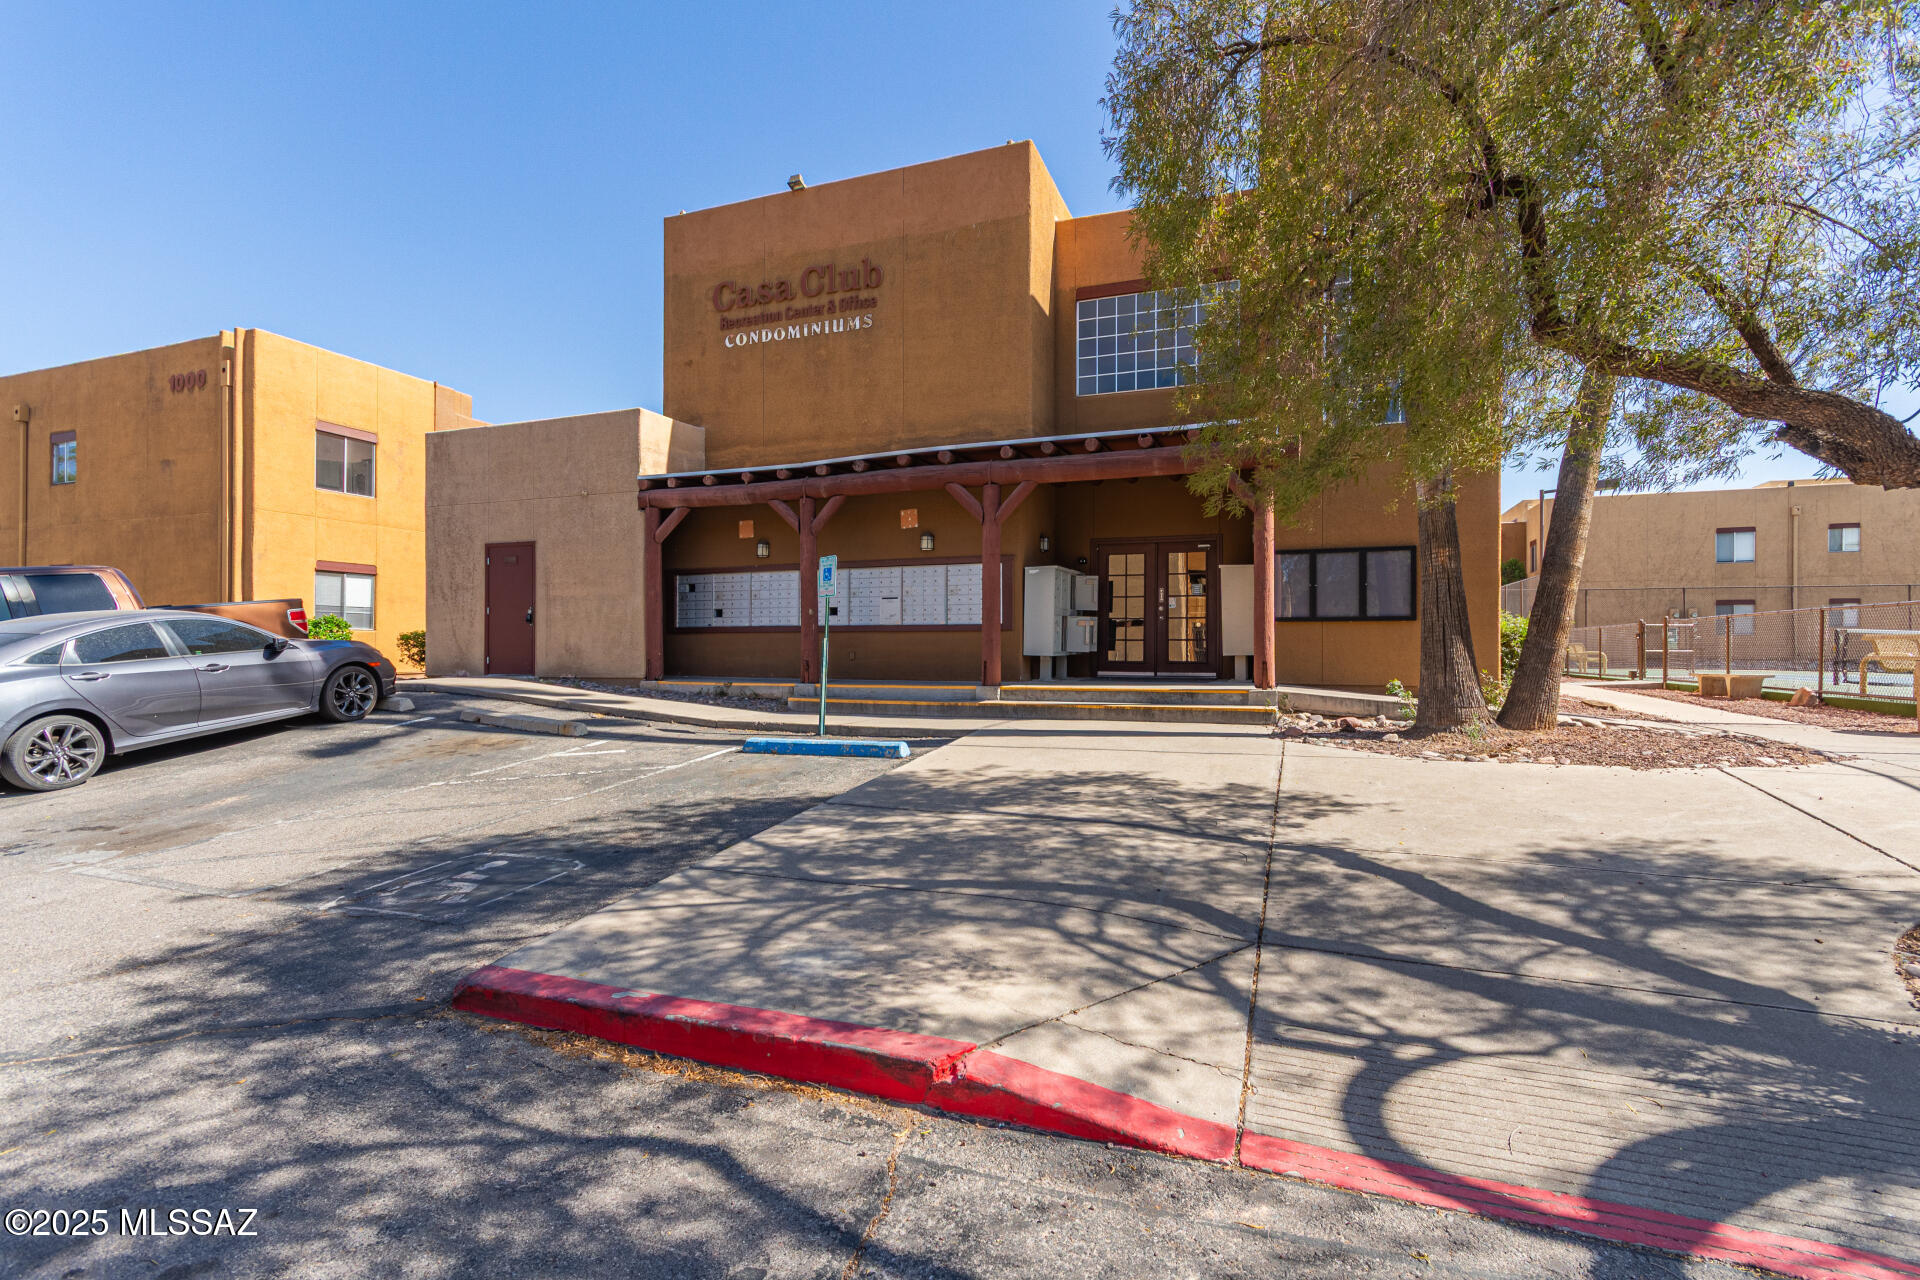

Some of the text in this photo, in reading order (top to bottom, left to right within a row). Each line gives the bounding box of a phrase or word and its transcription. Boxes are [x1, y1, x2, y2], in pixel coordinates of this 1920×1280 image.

[712, 257, 884, 312] Casa Club
[720, 310, 784, 331] Recreation
[724, 314, 874, 348] CONDOMINIUMS
[168, 369, 207, 393] 1000
